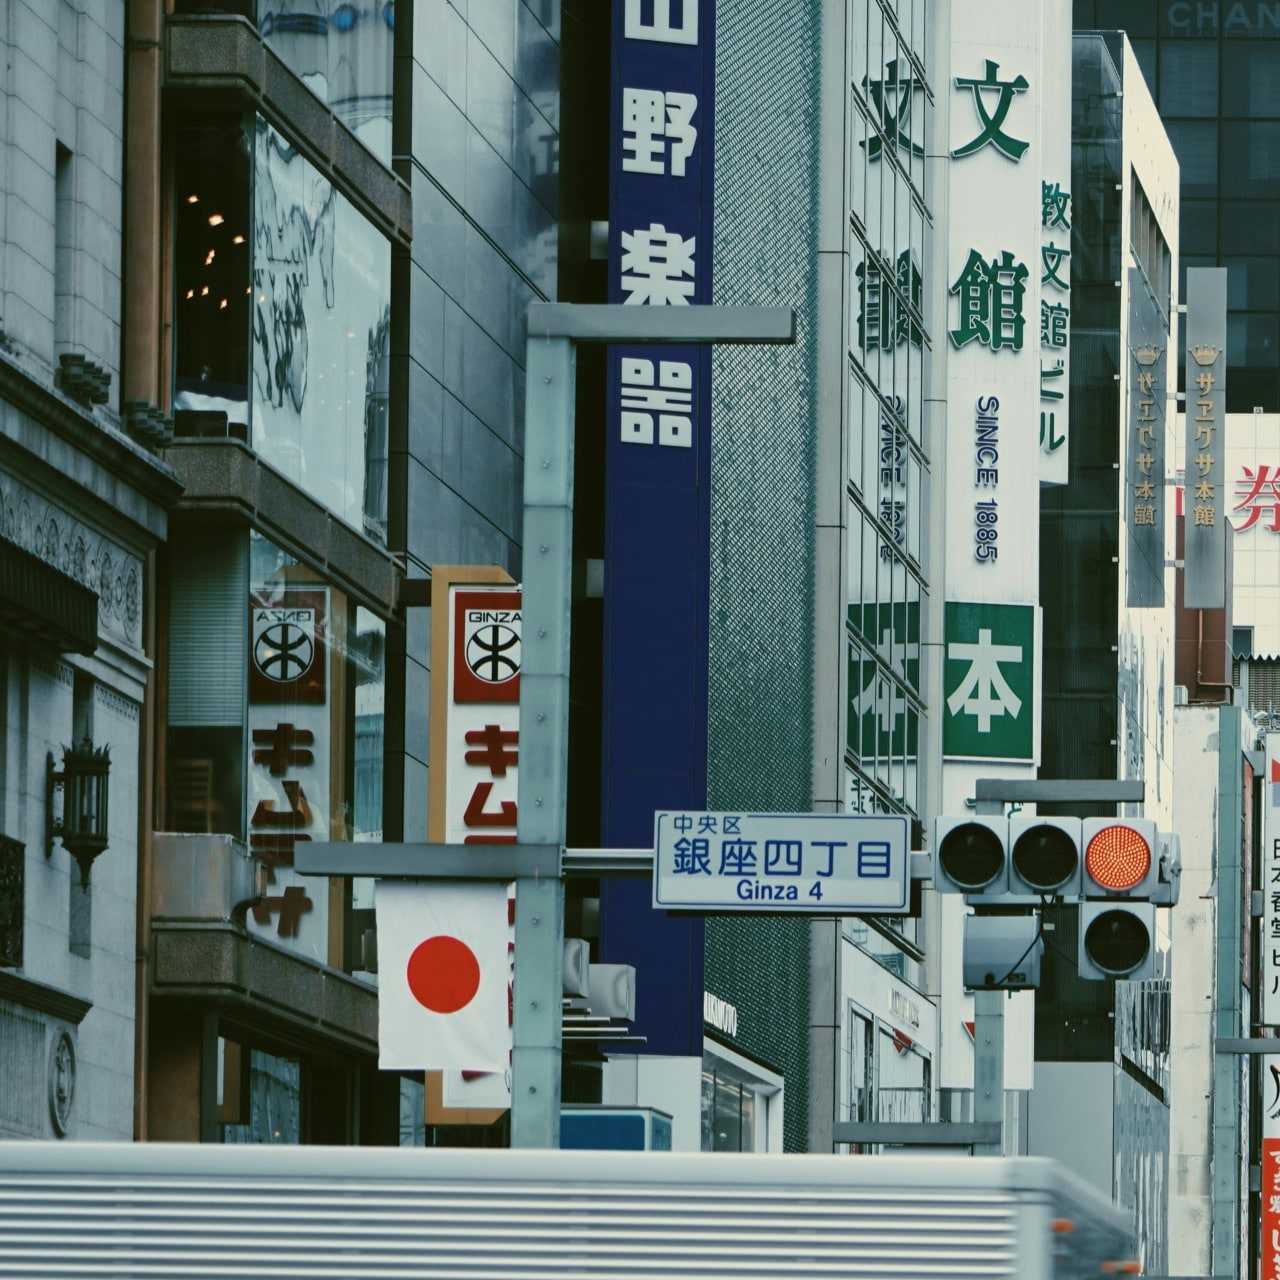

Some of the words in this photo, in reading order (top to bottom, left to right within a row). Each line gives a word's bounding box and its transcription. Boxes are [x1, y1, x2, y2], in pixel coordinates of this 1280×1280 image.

[975, 395, 1000, 486] SINCE
[974, 497, 999, 562] 1885
[468, 610, 522, 623] GINZA
[947, 628, 1023, 733] 本
[673, 813, 742, 835] 中央区
[672, 837, 892, 879] 銀座四丁目
[736, 879, 799, 900] Ginza
[808, 881, 824, 900] 4
